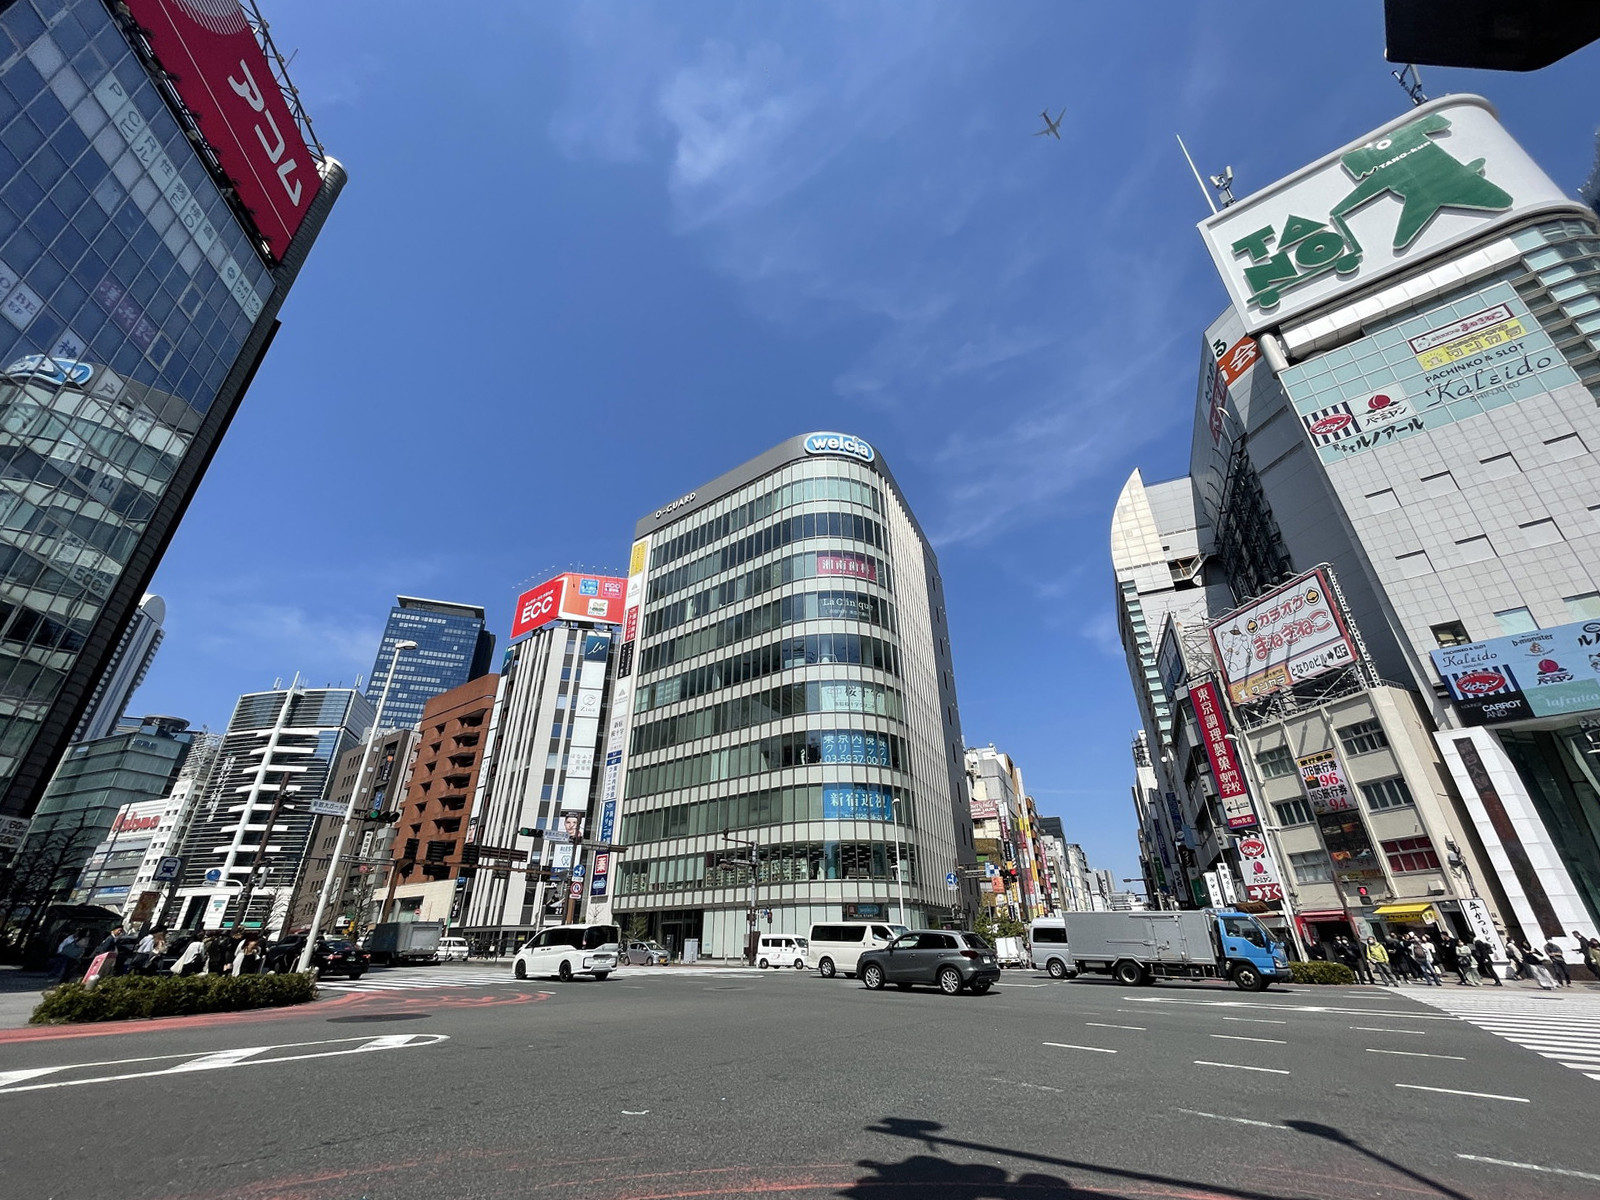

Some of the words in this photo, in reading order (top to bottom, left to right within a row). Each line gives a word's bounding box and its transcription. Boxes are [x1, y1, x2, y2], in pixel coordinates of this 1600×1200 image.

[227, 58, 304, 208] アコム
[1378, 139, 1433, 170] TANO-kun
[168, 191, 194, 229] ED
[1425, 357, 1483, 384] PACHINKO
[1485, 355, 1494, 363] &
[1495, 341, 1526, 359] SLOT
[1424, 353, 1552, 407] Kaleido
[1469, 380, 1520, 403] SHINJUKU
[1364, 406, 1409, 427] バーミヤン
[1355, 417, 1424, 449] ルノアール
[812, 436, 869, 459] welcia
[655, 492, 697, 519] O-GUARD
[521, 595, 553, 625] ECC
[836, 598, 874, 610] Cinque
[1256, 594, 1305, 630] カラオケ
[1252, 609, 1333, 661] まねきねこ
[1512, 633, 1554, 647] b-monster
[1335, 645, 1349, 660] 4F
[1442, 650, 1498, 668] Kaleido
[1290, 656, 1328, 676] となりのビル
[1250, 674, 1287, 693] ワンカラ
[1537, 674, 1575, 686] バーミヤン
[1482, 699, 1521, 713] CARROT
[1486, 709, 1508, 719] AND
[825, 744, 886, 756] クリニック
[830, 792, 887, 809] 新宿近視
[1261, 884, 1283, 899] すぐ
